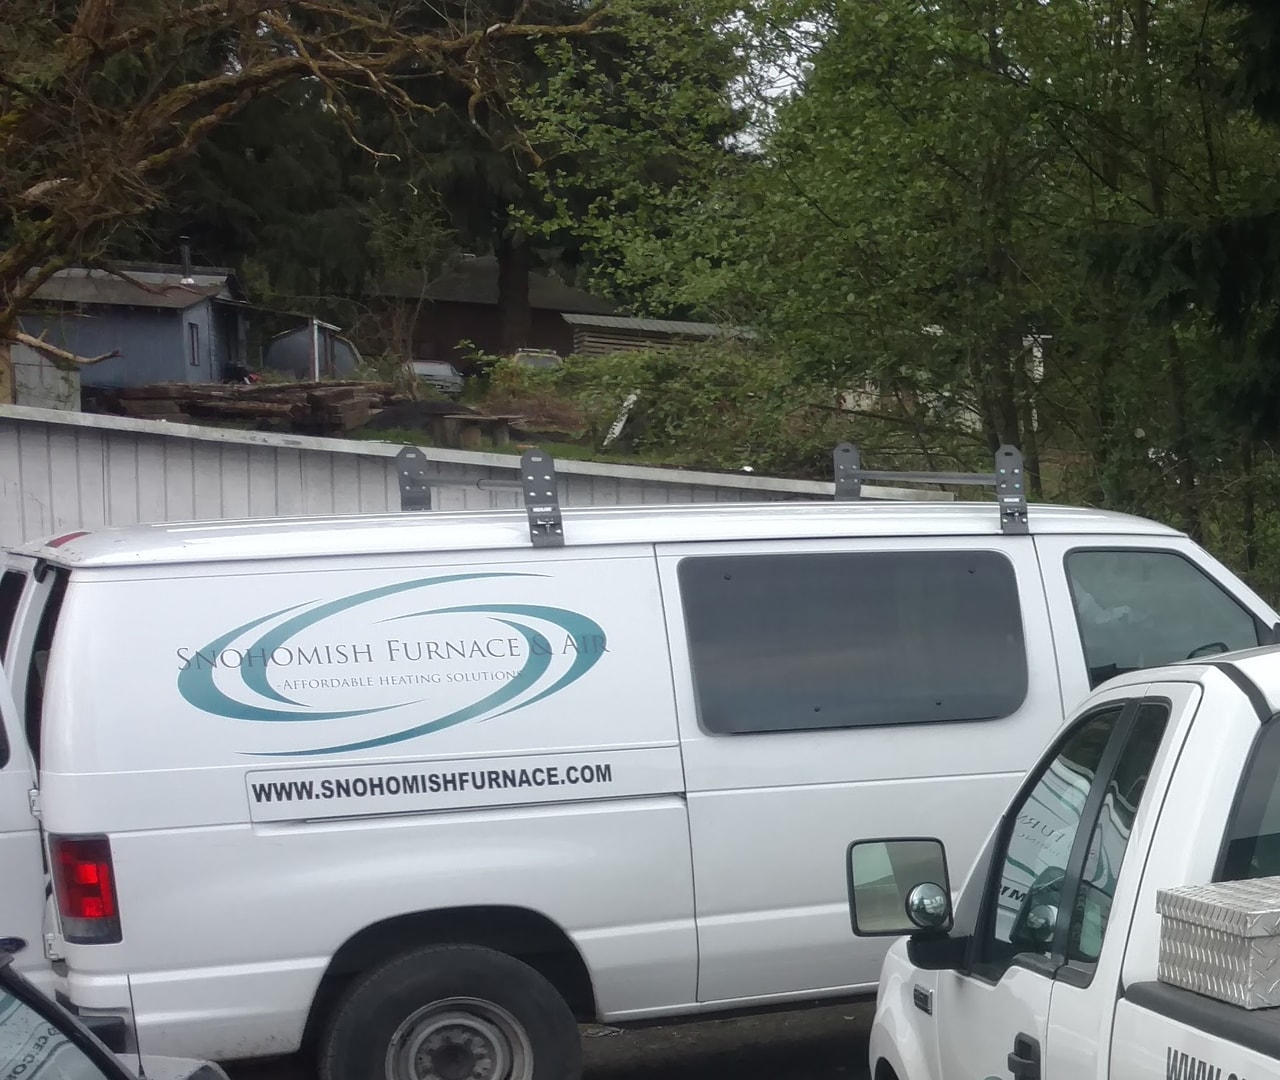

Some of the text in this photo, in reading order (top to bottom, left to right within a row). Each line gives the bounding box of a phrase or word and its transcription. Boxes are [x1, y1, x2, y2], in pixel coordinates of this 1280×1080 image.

[176, 633, 612, 672] SNOHOMISH FURNACE & AIR
[379, 672, 442, 687] HEATING
[251, 763, 613, 803] WWW.SNOHOMISHFURNACE.COM
